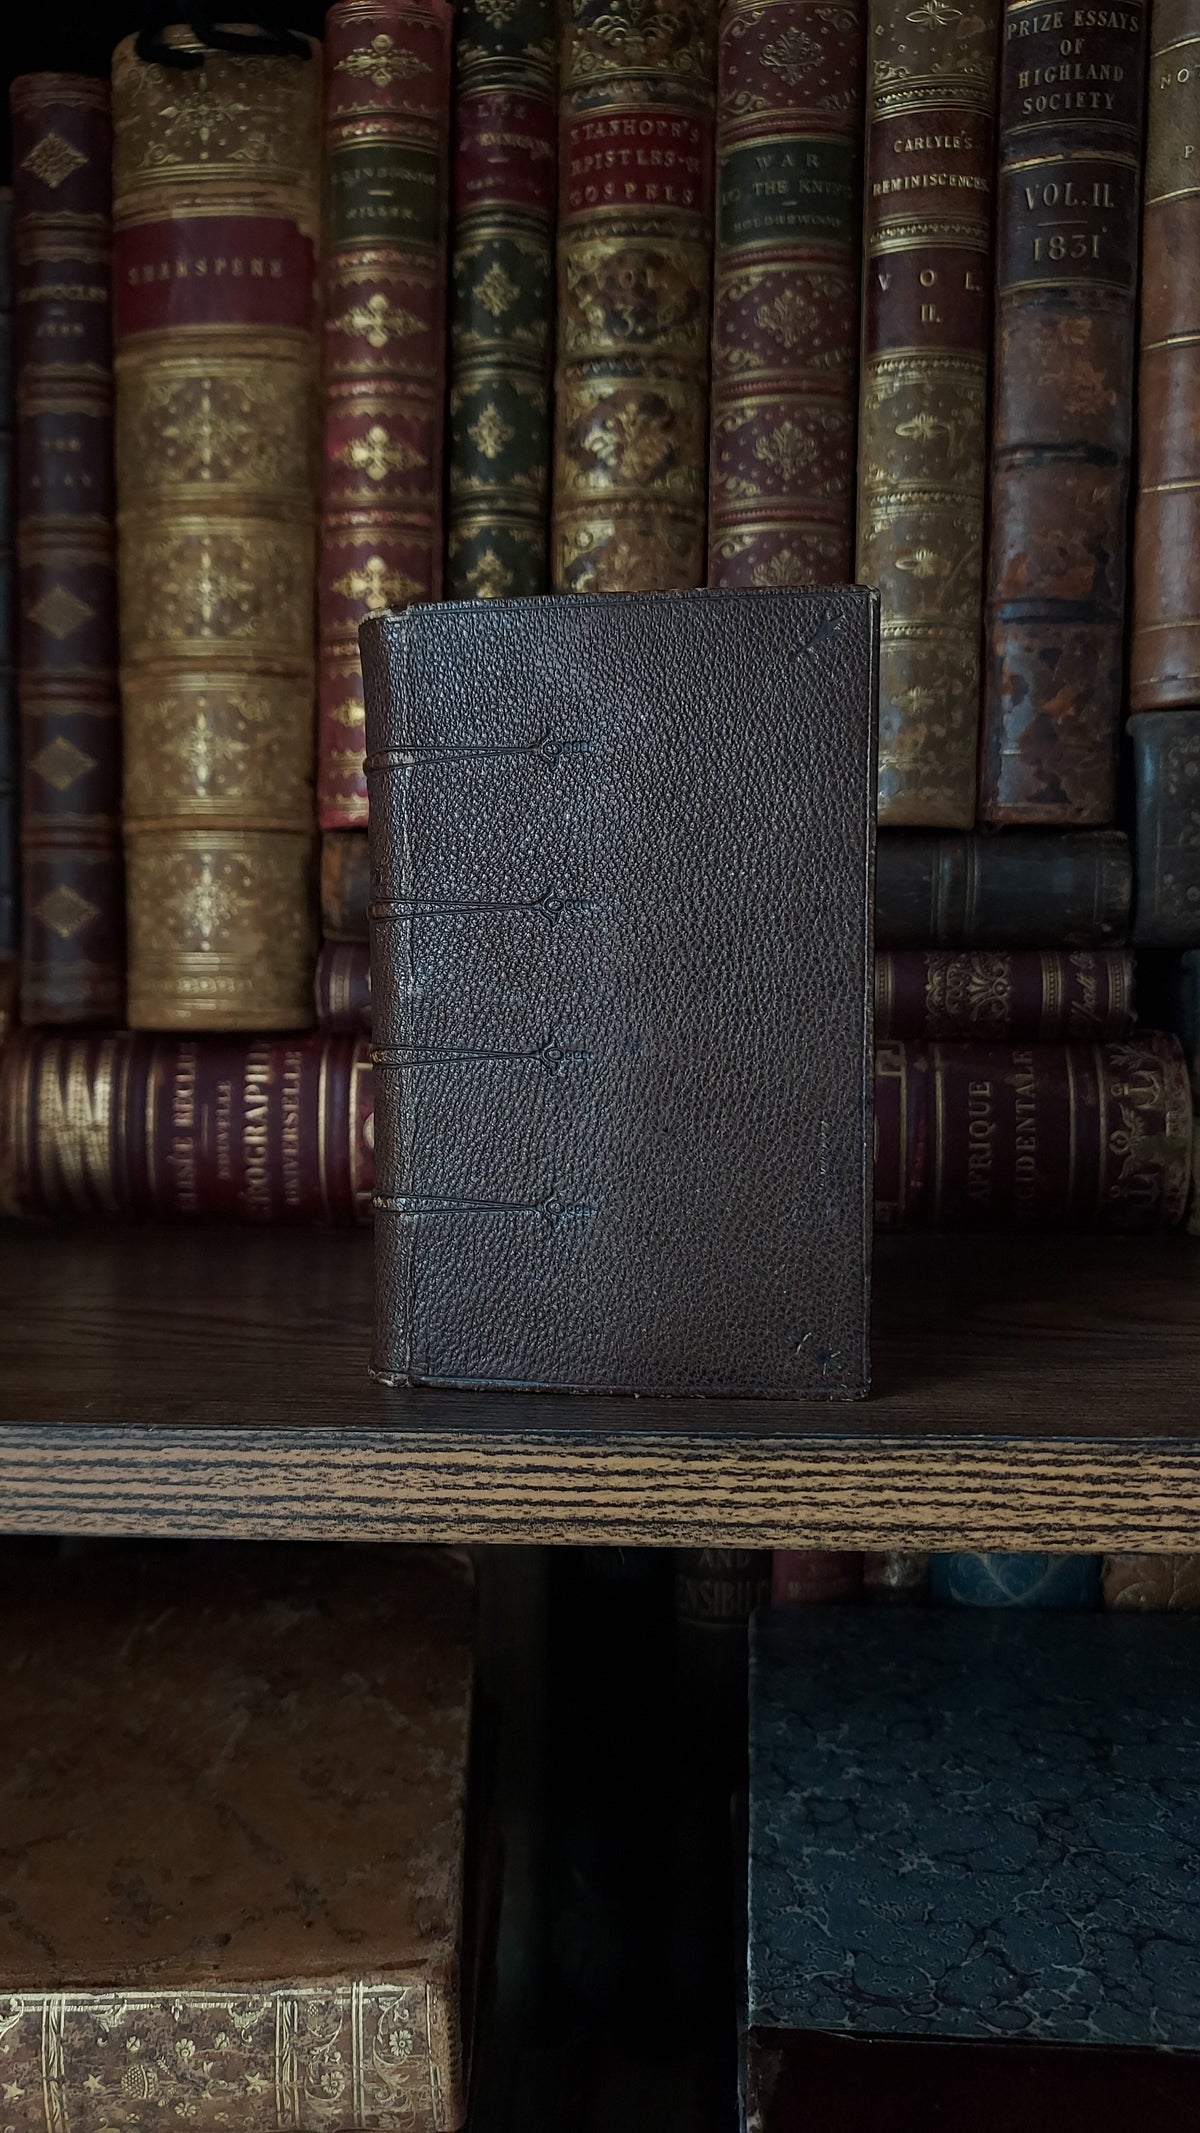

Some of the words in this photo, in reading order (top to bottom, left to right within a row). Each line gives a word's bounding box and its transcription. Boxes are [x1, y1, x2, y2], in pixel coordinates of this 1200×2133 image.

[1007, 11, 1064, 40] PRIZE
[1072, 9, 1140, 33] ESSAYS
[1060, 38, 1085, 56] OF
[1017, 64, 1124, 89] HIGHLAND
[1022, 92, 1116, 115] SOCIETY
[893, 130, 973, 153] CARLYLE'S
[755, 153, 819, 169] WAR
[752, 180, 789, 196] THE
[873, 173, 990, 197] REMINISCENCES
[1025, 182, 1087, 210] VOL.
[1033, 234, 1101, 262] 1831
[921, 303, 942, 323] II.
[967, 1080, 996, 1203] AFRIQUE
